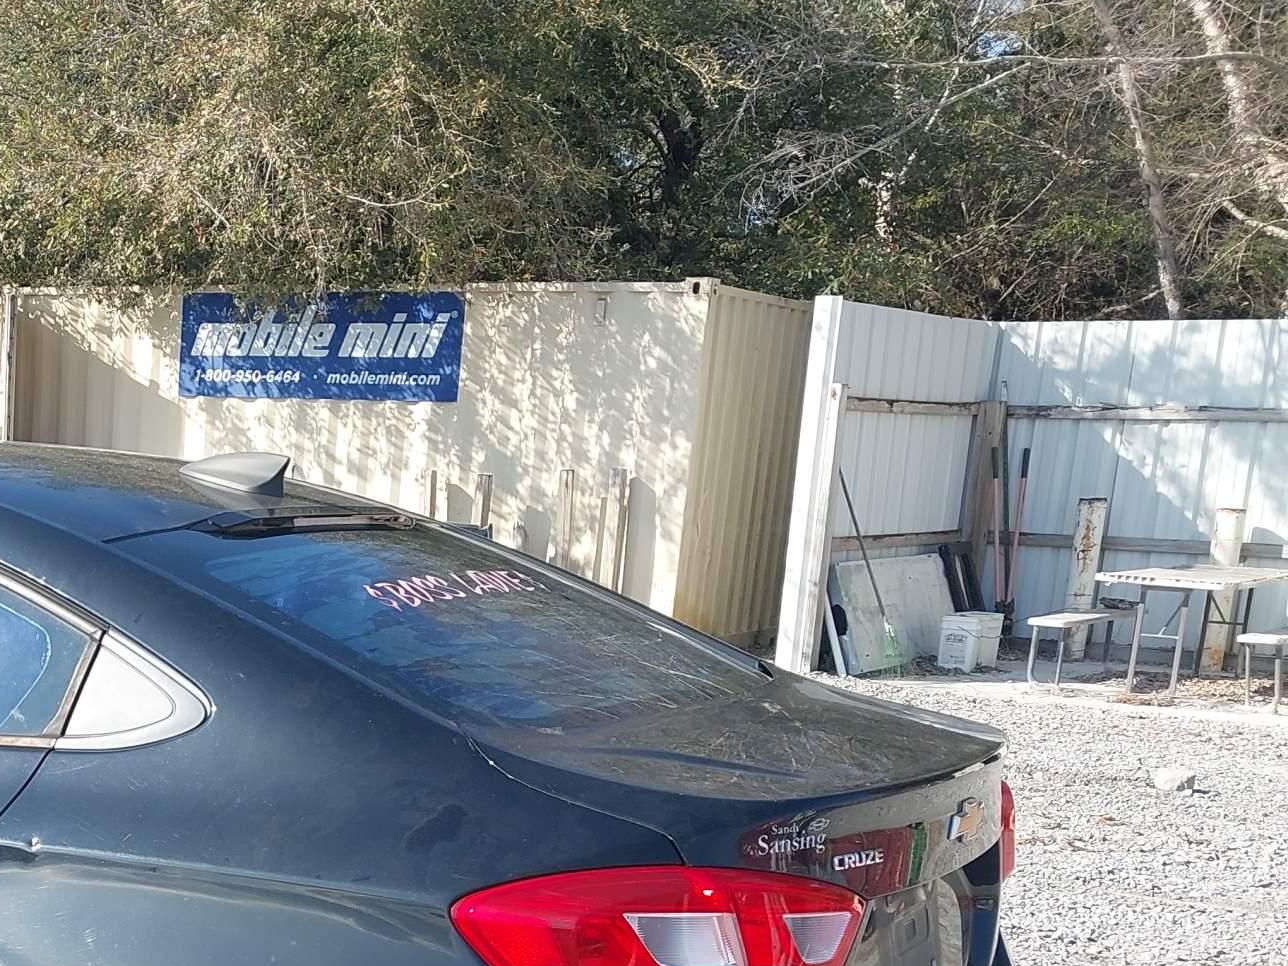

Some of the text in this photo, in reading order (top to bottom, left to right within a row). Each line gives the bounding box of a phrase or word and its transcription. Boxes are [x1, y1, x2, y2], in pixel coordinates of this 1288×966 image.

[191, 305, 451, 358] mobile mini
[195, 368, 441, 386] 1-800-950-6464 mobilemini.com
[772, 822, 800, 838] Sandy
[758, 833, 827, 856] Sansing
[833, 848, 885, 871] CRUZE
